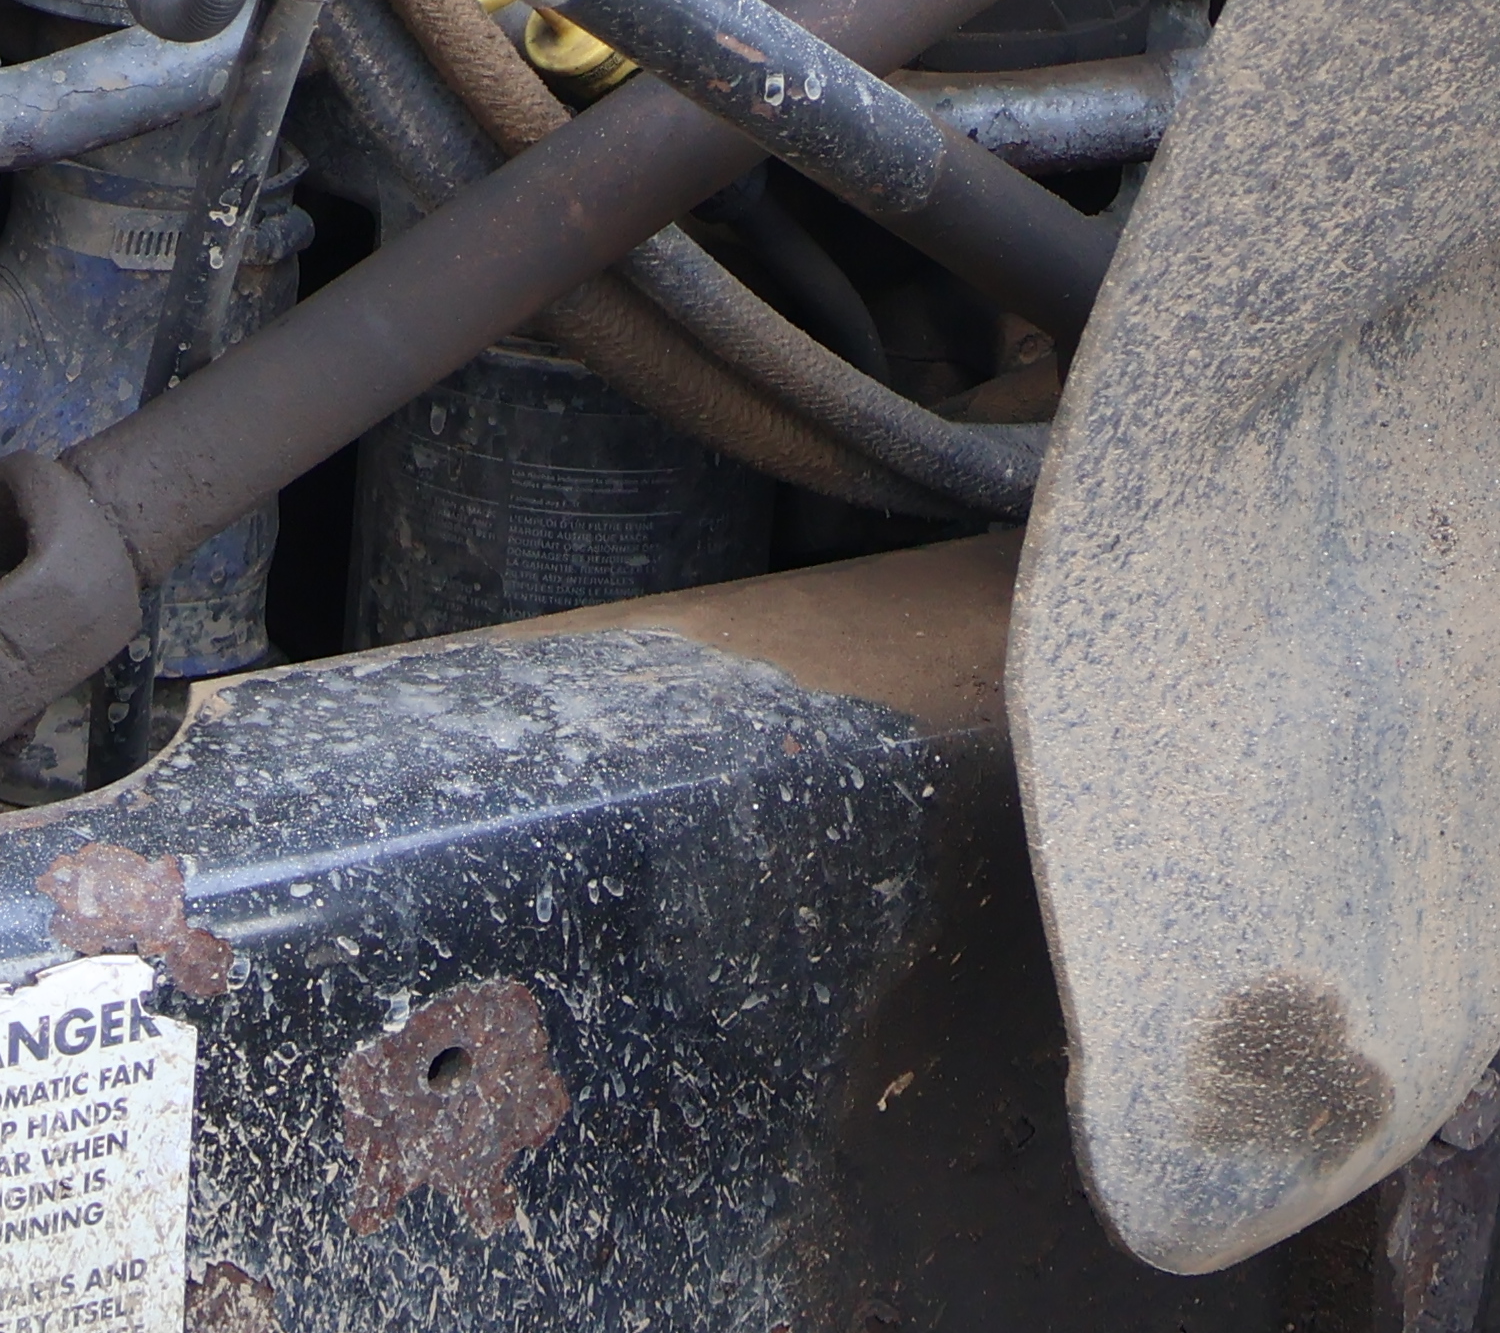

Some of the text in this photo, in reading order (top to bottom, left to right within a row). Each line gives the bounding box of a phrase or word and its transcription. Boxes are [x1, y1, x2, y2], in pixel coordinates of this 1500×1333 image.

[98, 1057, 156, 1092] FAN
[27, 1096, 129, 1141] HANDS
[41, 1129, 129, 1168] WHEN
[83, 1168, 108, 1195] IS
[84, 1257, 149, 1293] AND
